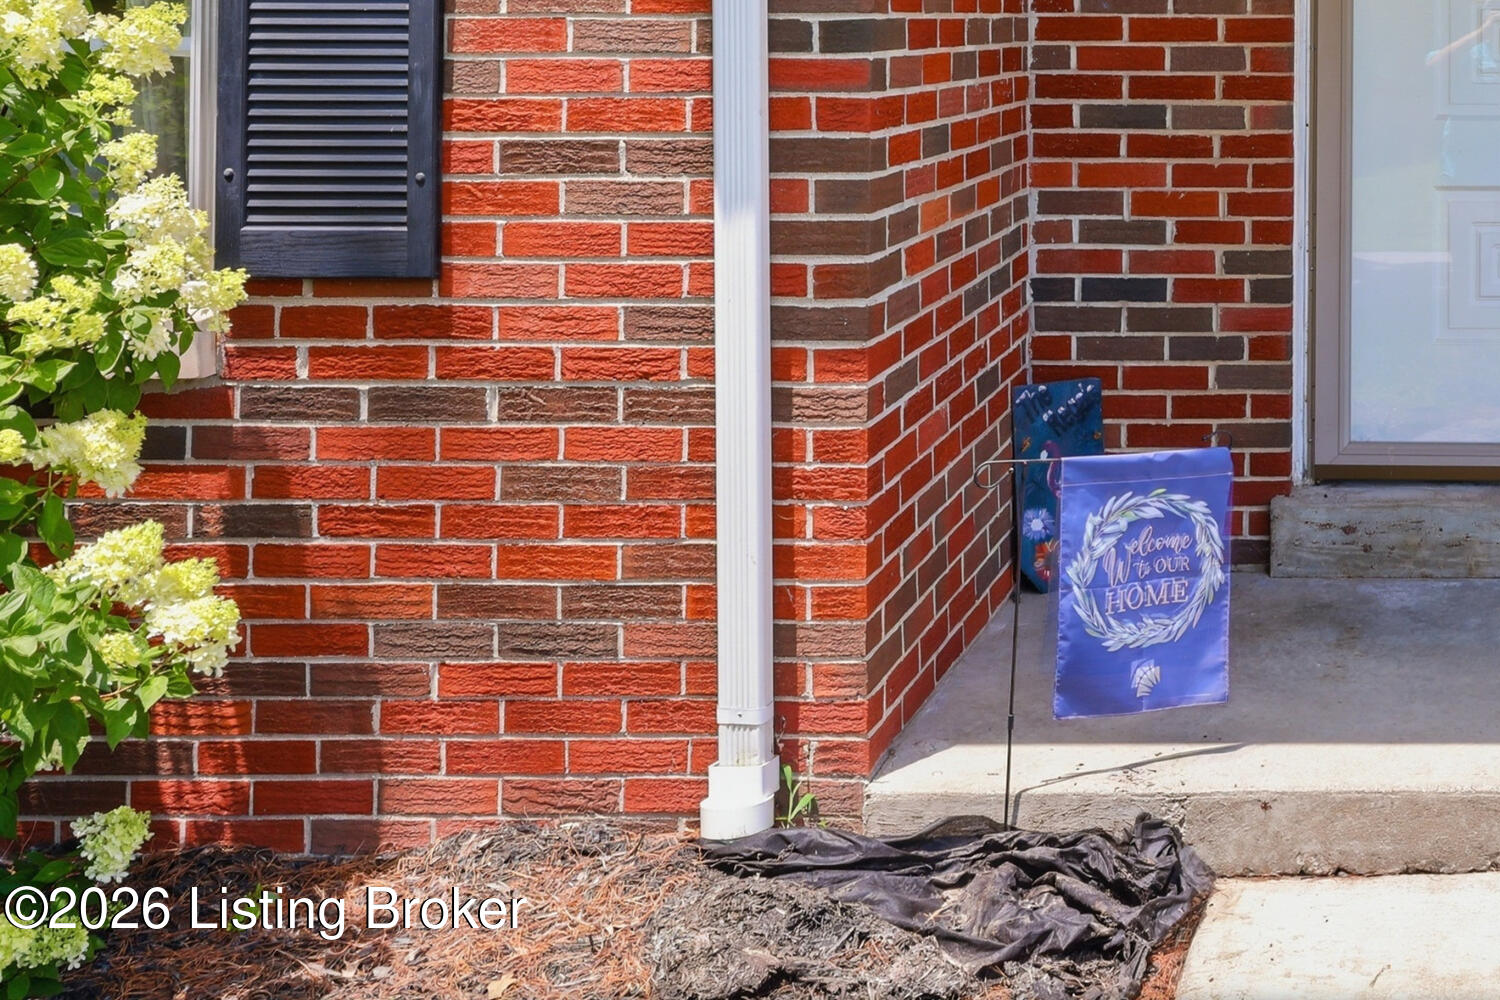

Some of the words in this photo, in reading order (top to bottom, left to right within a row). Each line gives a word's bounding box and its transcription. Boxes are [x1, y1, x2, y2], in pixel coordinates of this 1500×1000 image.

[1103, 526, 1193, 588] Welcome
[1133, 560, 1152, 579] to
[1154, 556, 1190, 574] OUR
[1105, 578, 1189, 616] HOME
